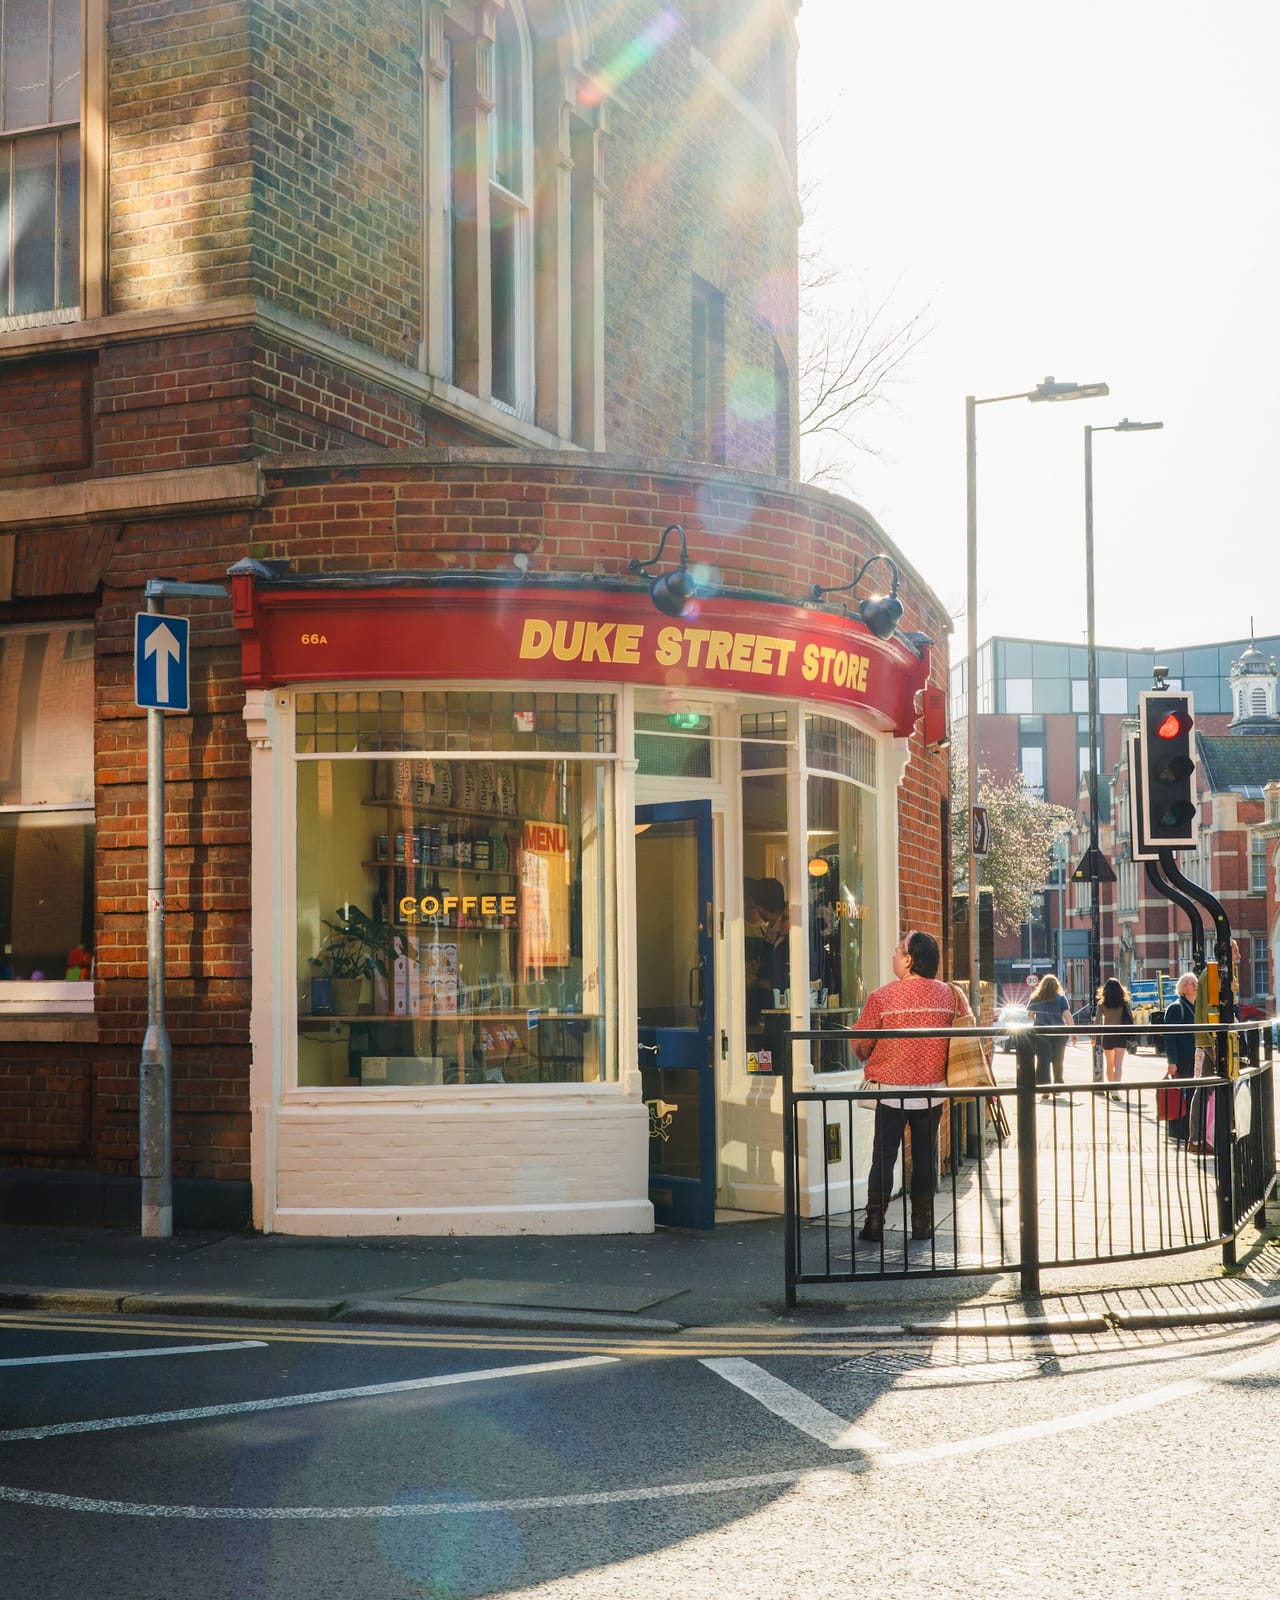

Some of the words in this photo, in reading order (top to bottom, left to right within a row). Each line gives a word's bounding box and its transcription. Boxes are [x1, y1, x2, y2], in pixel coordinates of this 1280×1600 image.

[301, 633, 328, 645] 66A
[519, 618, 643, 665] DUKE
[655, 625, 797, 677] STREET
[801, 643, 870, 695] STORE
[524, 823, 567, 854] MENU
[399, 896, 516, 915] COFFEE
